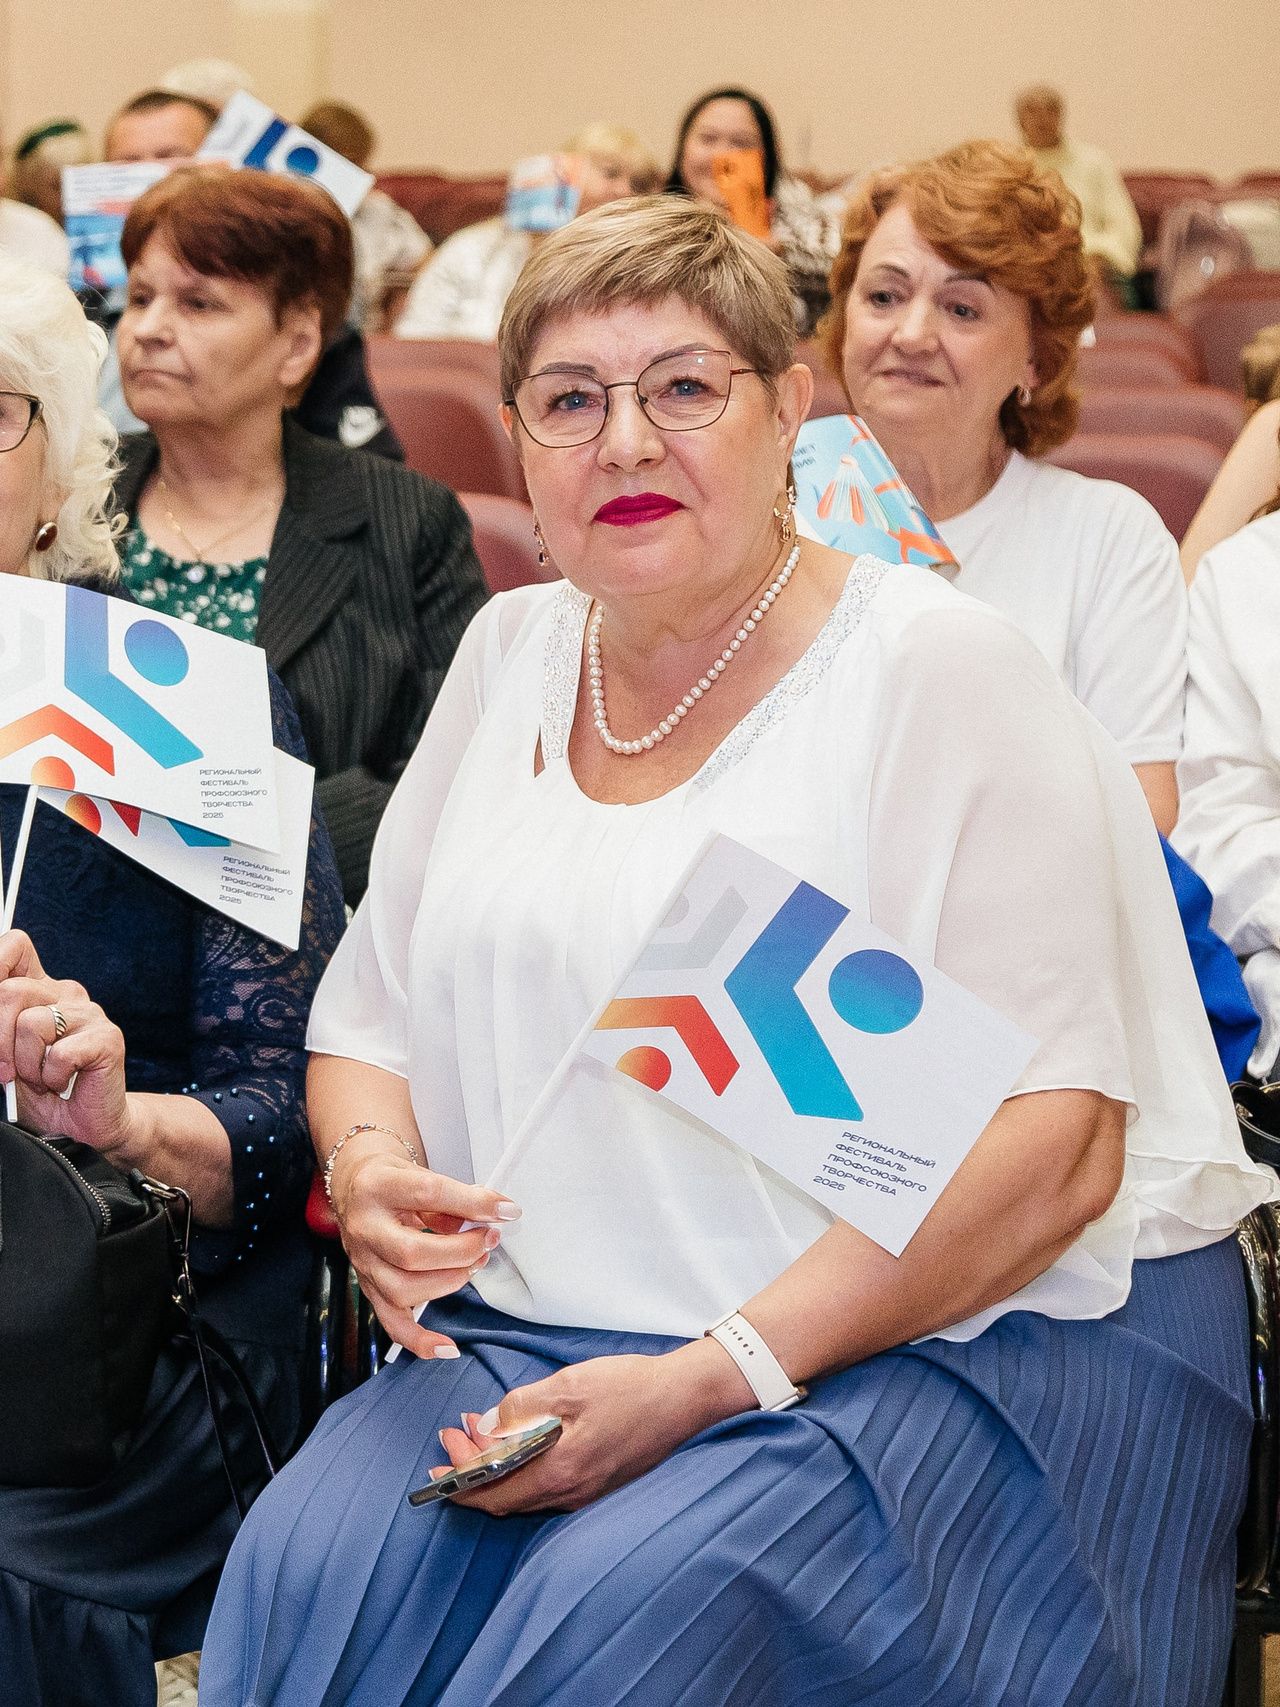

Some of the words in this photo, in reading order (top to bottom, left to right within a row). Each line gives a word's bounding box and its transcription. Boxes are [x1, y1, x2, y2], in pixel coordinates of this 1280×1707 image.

[200, 779, 249, 787] ФЕСТИВАЛЬ
[201, 789, 267, 797] ПРОФСОЮЗНОГО
[201, 800, 254, 808] ТВОРЧЕСТВА
[222, 866, 275, 883] ФЕСТИВАЛЬ
[223, 855, 291, 876] РЕГИОНАЛЬНЫЙ
[220, 884, 276, 902] ТВОРЧЕСТВА
[221, 875, 294, 896] ПРОФСОЮЗНОГО
[219, 894, 242, 905] 2025
[835, 1143, 907, 1173] ФЕСТИВАЛЬ
[842, 1131, 937, 1169] РЕГИОНАЛЬНЫЙ
[822, 1164, 897, 1196] ТВОРЧЕСТВА
[827, 1153, 928, 1192] ПРОФСОЮЗНОГО
[813, 1175, 847, 1191] 2025
